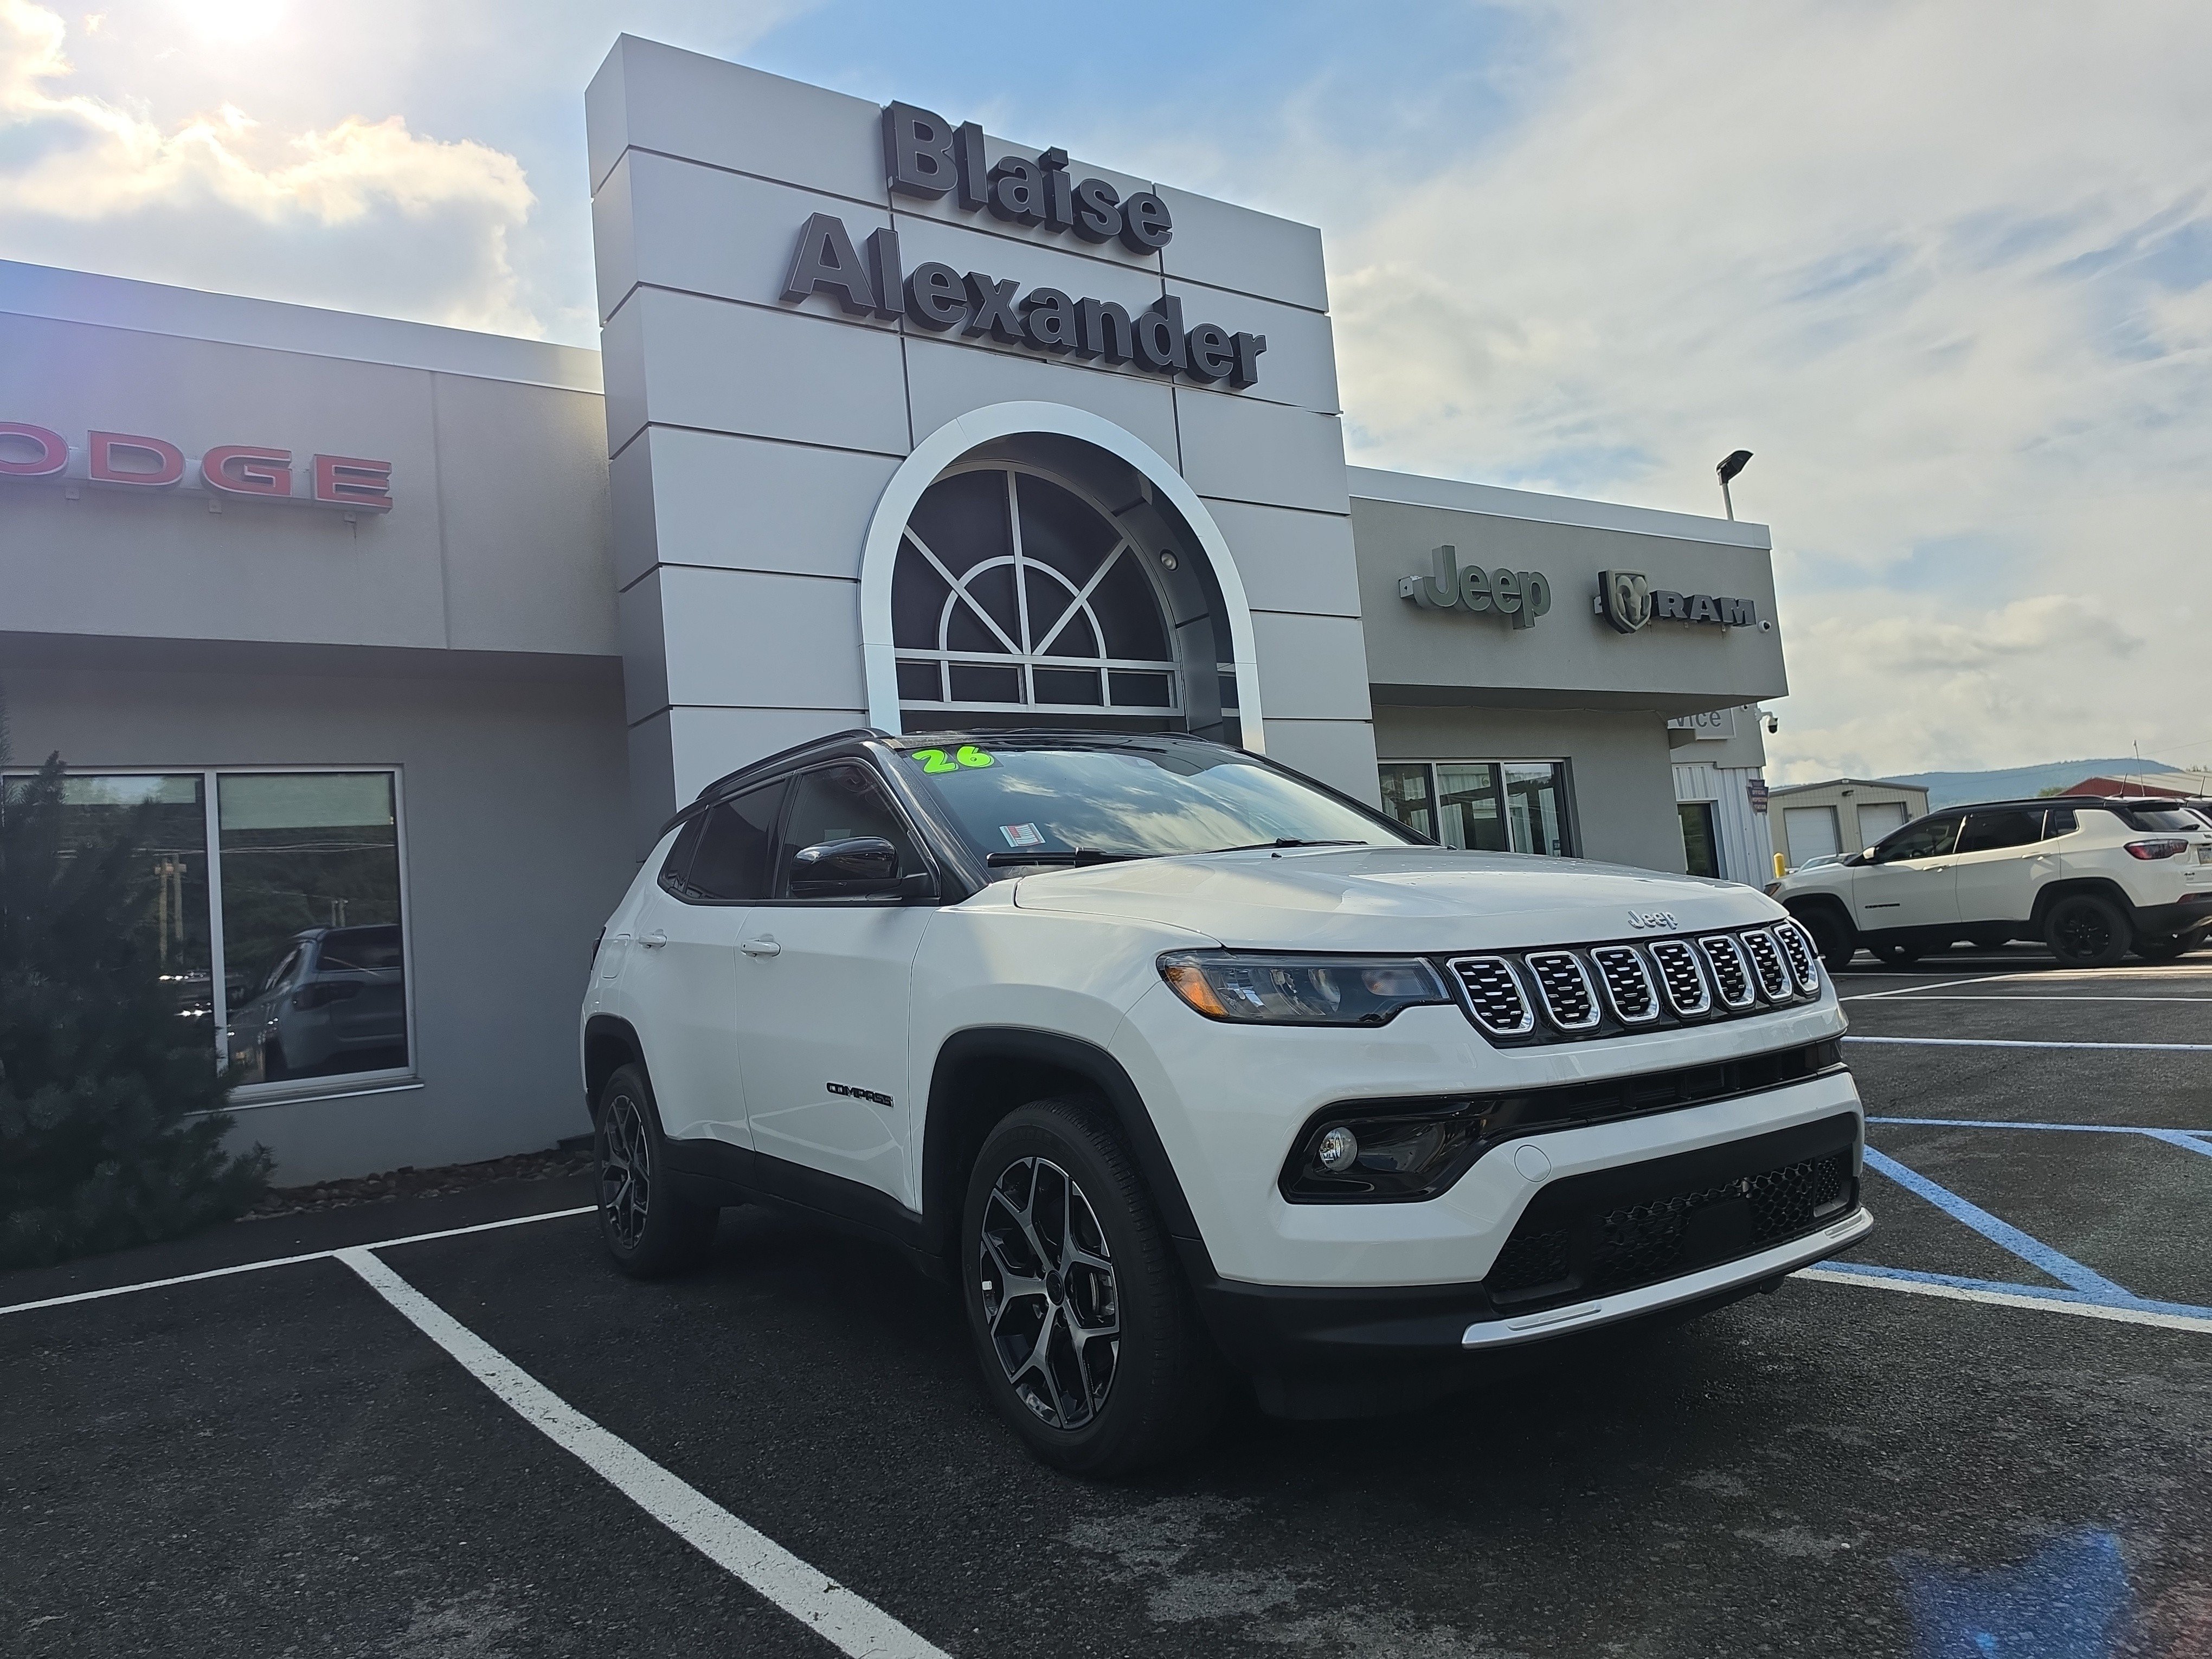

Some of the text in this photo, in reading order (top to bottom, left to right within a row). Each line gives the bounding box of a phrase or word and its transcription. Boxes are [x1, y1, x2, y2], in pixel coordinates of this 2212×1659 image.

[883, 100, 1173, 255] Blaise
[780, 212, 1266, 389] Alexander
[1413, 545, 1551, 629] Jeep
[1654, 590, 1756, 626] RAM
[911, 746, 994, 773] 26
[1628, 910, 1678, 930] Jeep
[826, 1082, 894, 1108] COMPASS
